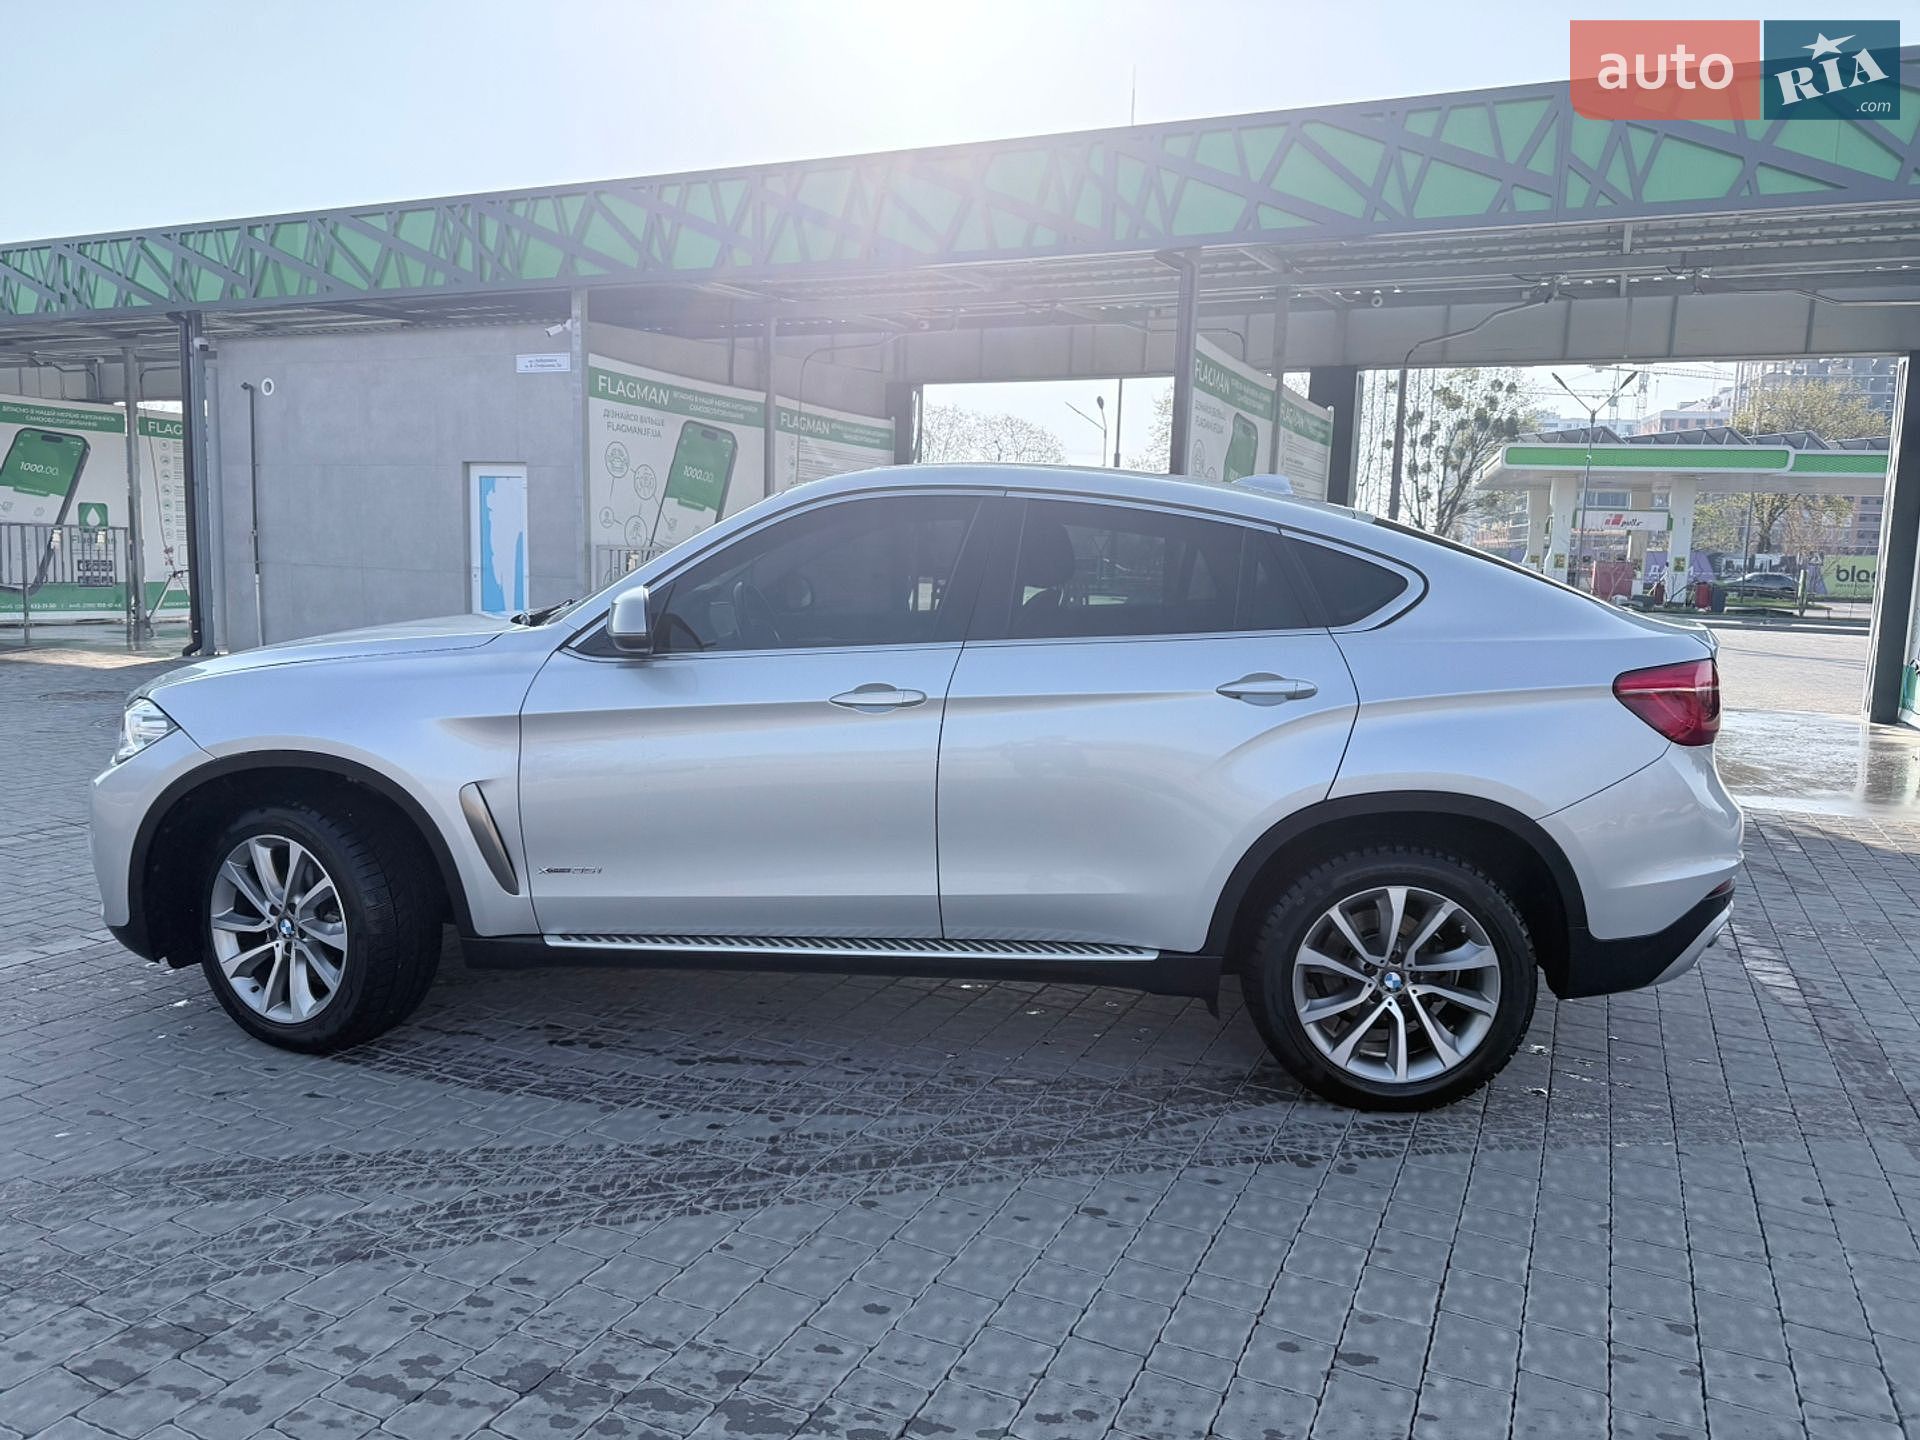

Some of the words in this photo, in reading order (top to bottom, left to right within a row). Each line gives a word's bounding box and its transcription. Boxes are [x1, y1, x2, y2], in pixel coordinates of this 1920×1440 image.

[598, 374, 670, 406] FLAGMAN
[1194, 358, 1230, 395] FLAGMAN
[780, 411, 830, 435] FLAGMAN
[20, 460, 59, 476] 1000.00
